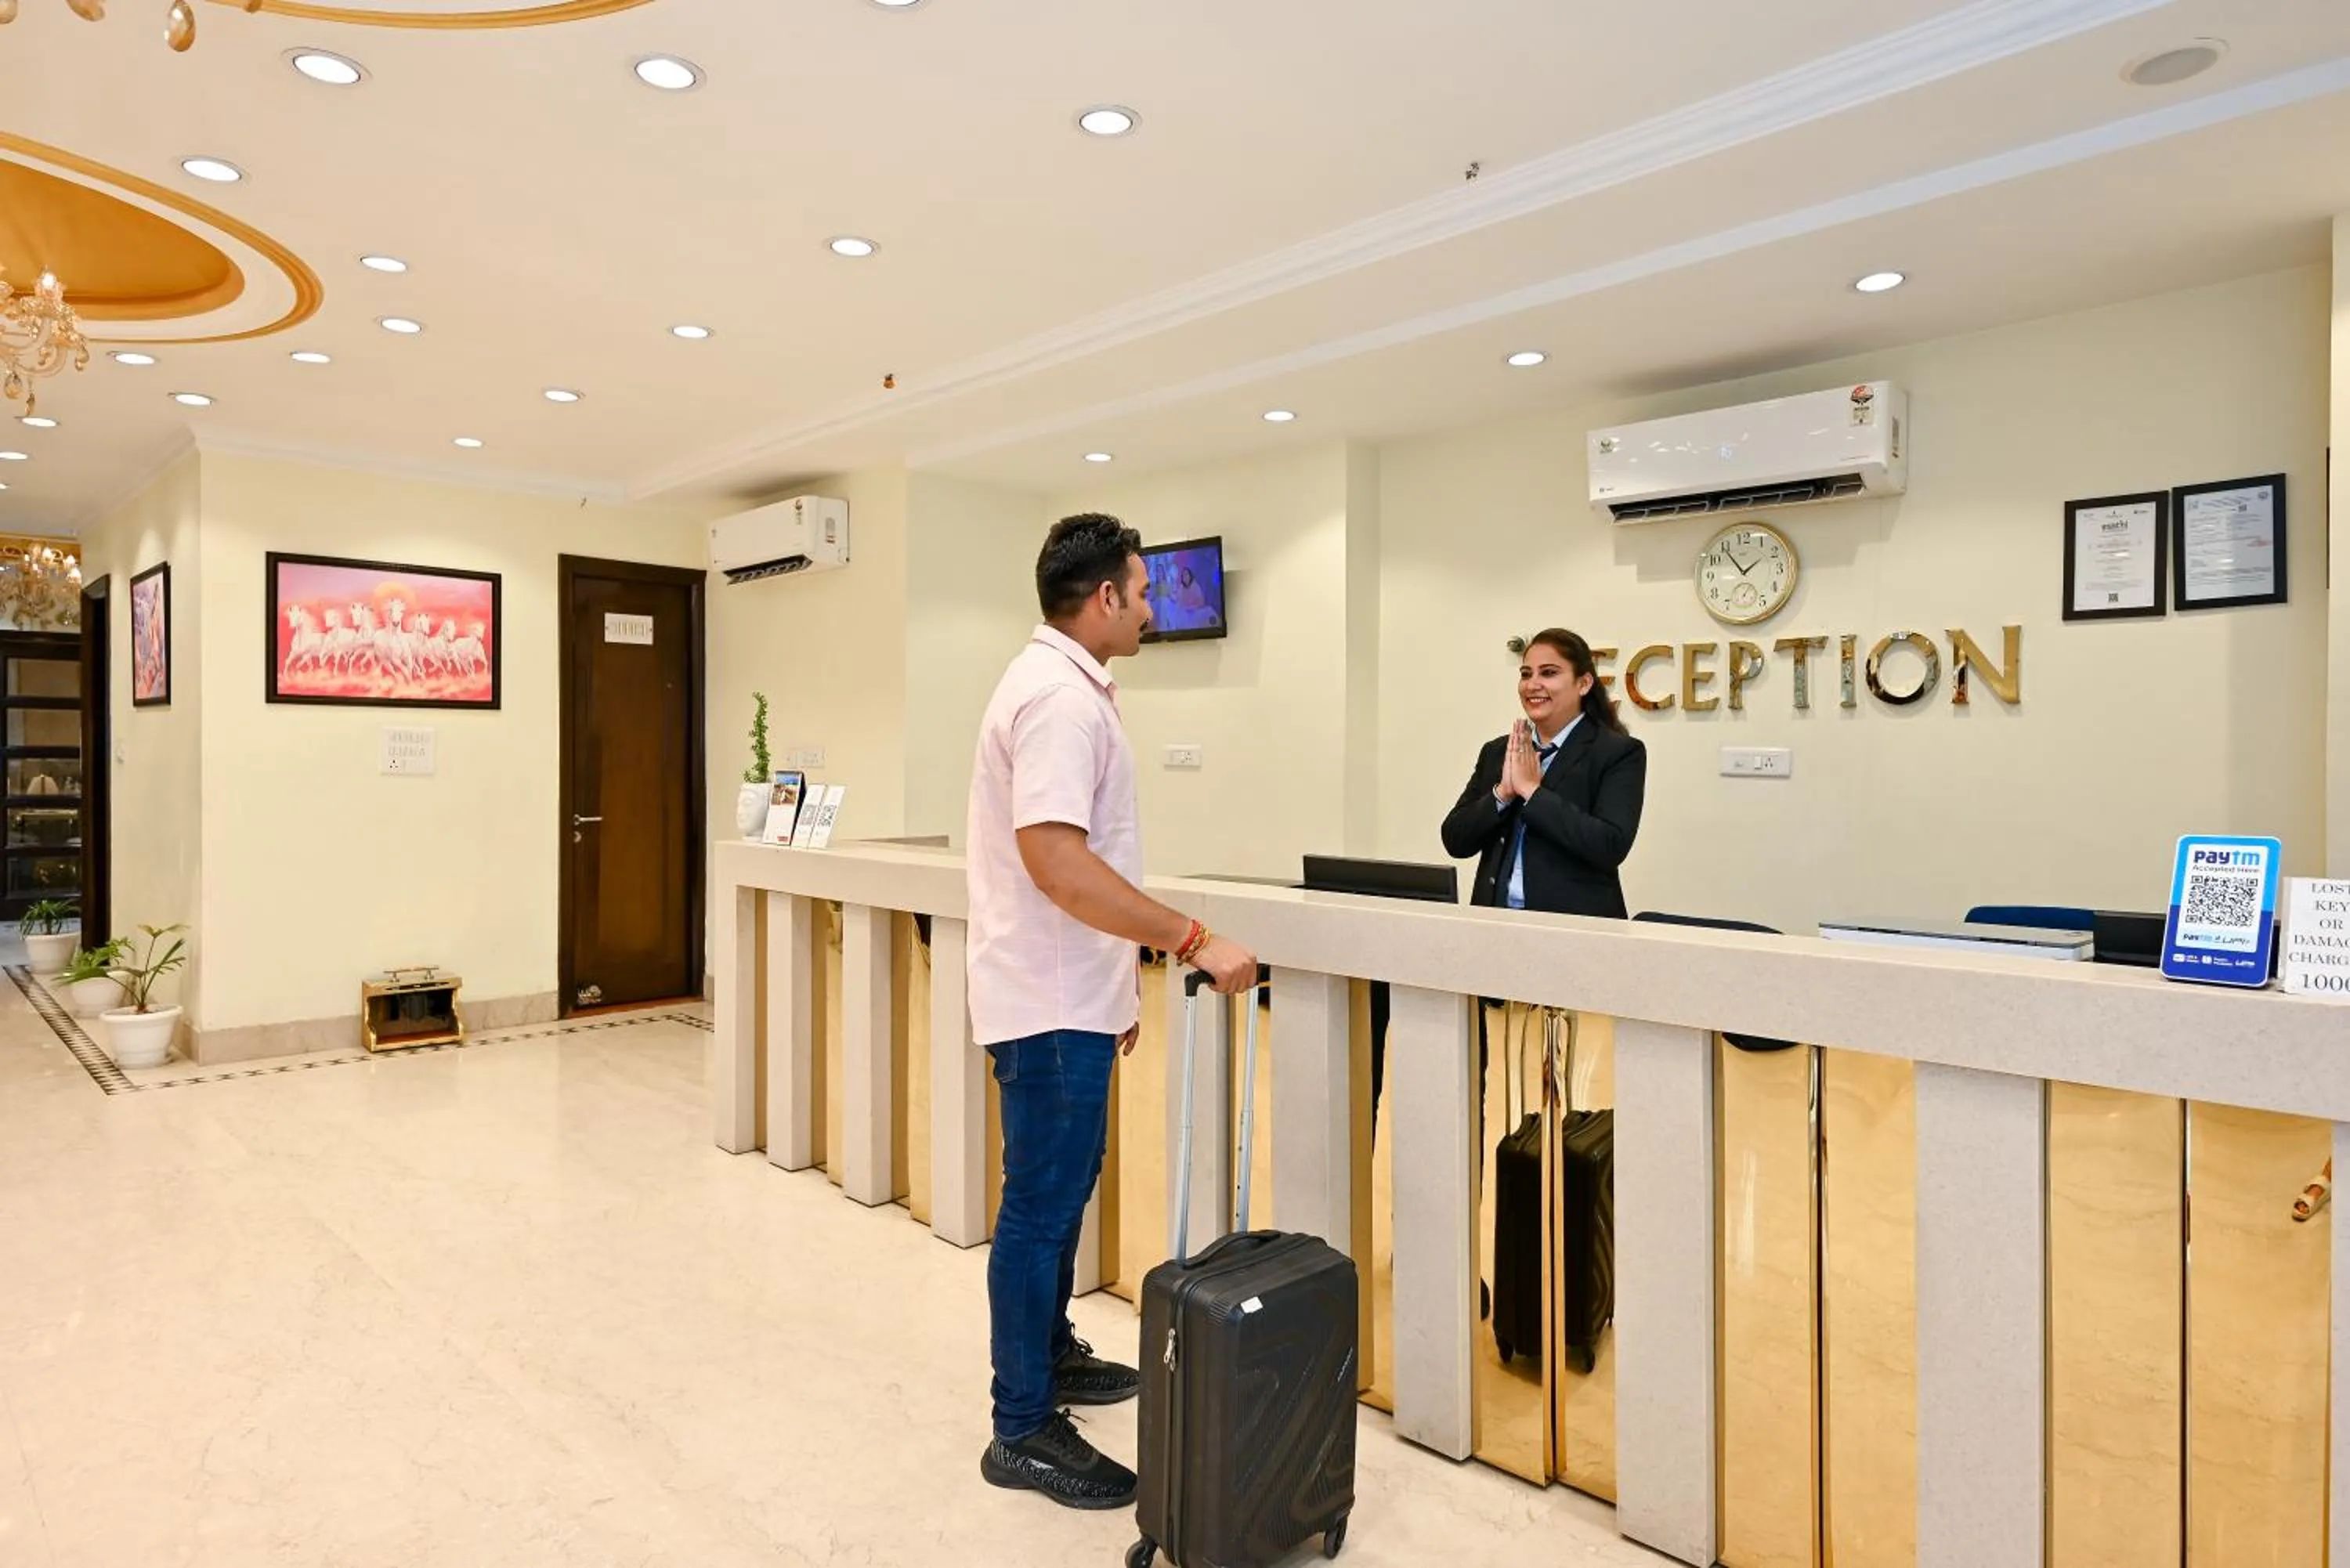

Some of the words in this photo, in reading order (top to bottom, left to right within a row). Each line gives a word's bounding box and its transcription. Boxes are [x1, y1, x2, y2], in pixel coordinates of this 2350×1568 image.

[1737, 532, 1751, 545] 12
[1770, 546, 1778, 558] 2
[1710, 554, 1721, 566] 10
[1776, 562, 1784, 575] 3
[2319, 919, 2344, 930] OR
